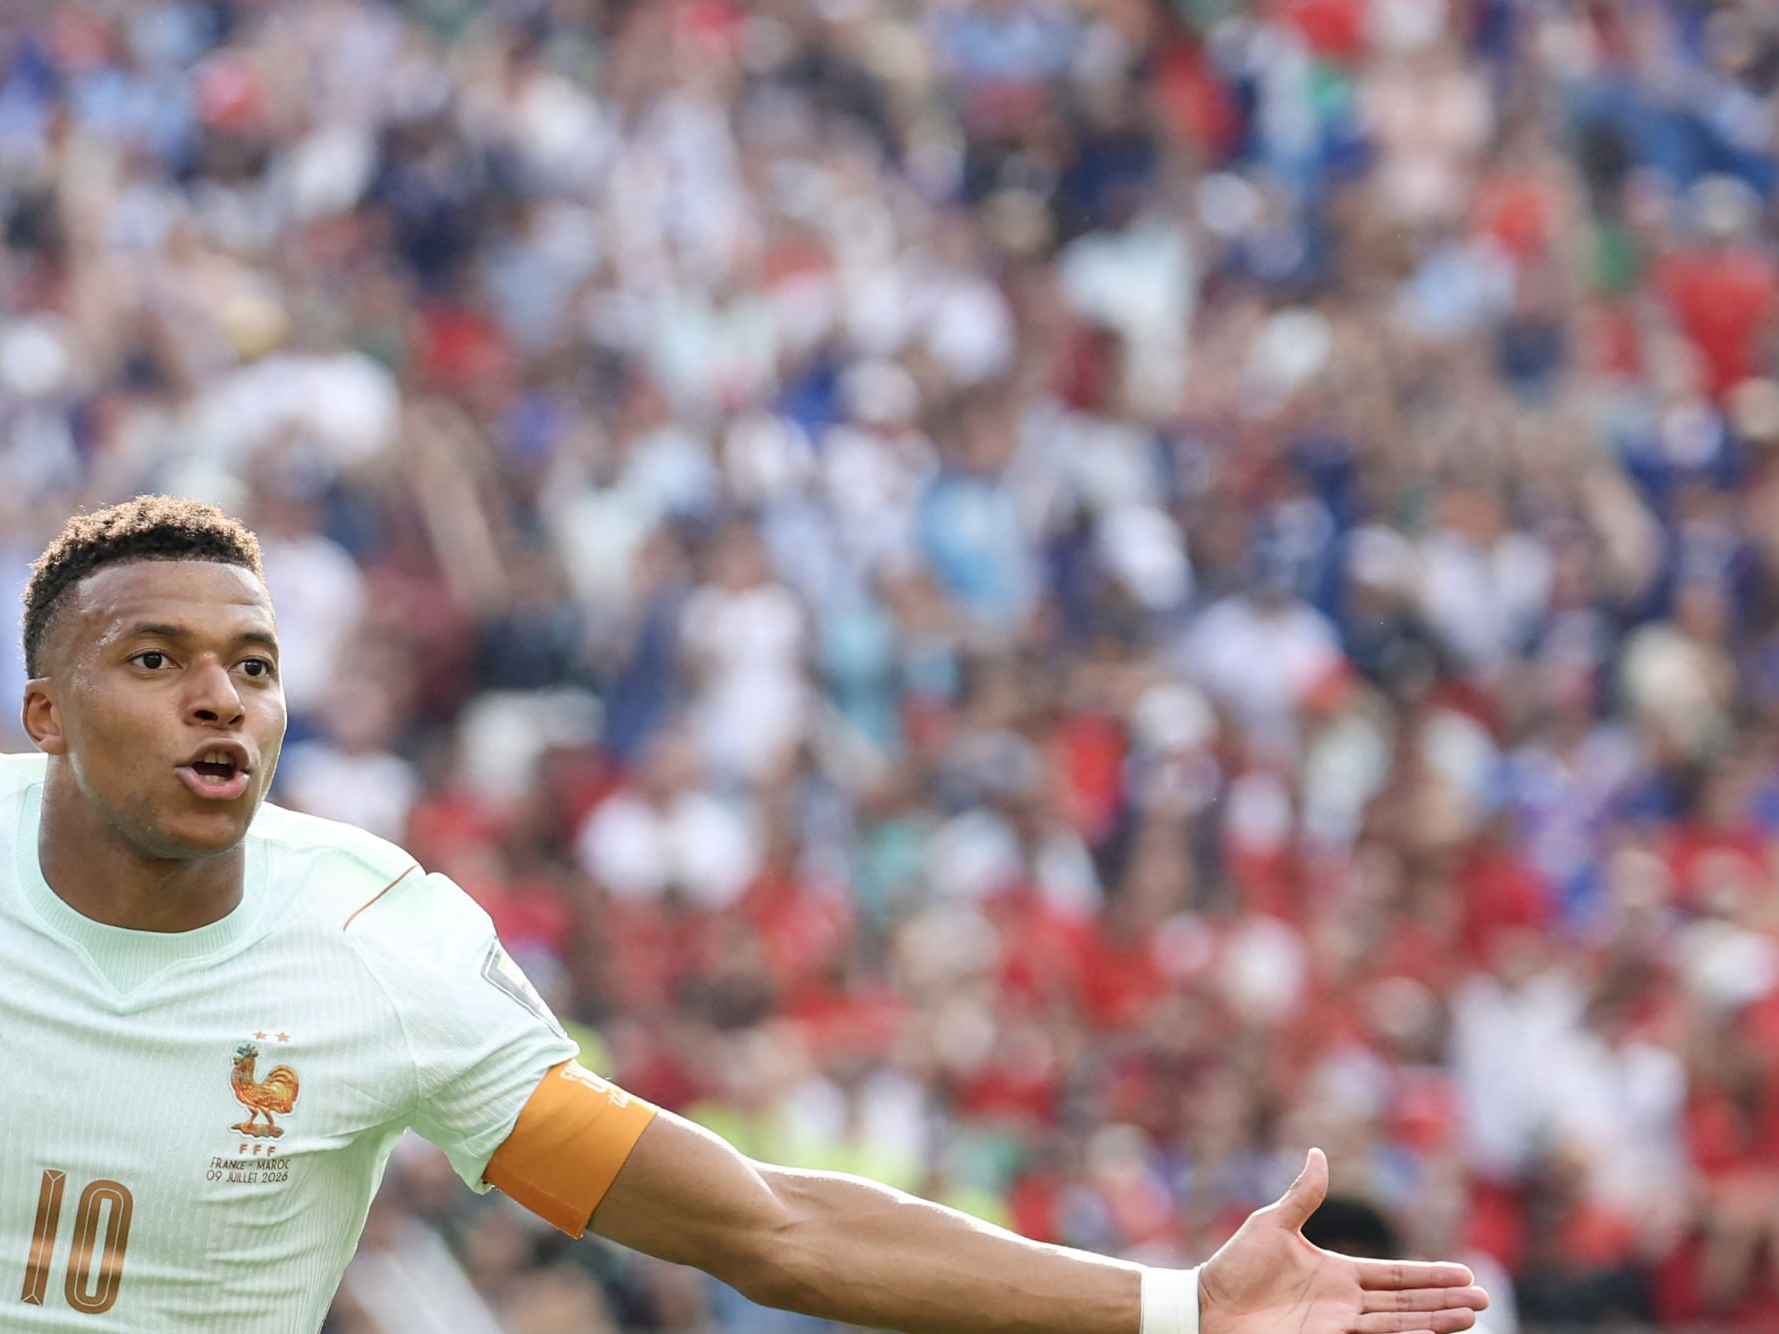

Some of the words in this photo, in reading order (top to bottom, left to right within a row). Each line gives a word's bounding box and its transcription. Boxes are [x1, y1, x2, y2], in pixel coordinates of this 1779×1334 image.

[210, 1156, 246, 1170] FRANCE
[256, 1159, 290, 1170] MAROC
[206, 1169, 223, 1182] 09
[226, 1171, 258, 1184] JUILLET
[261, 1171, 288, 1184] 2026
[21, 1168, 134, 1315] 10
